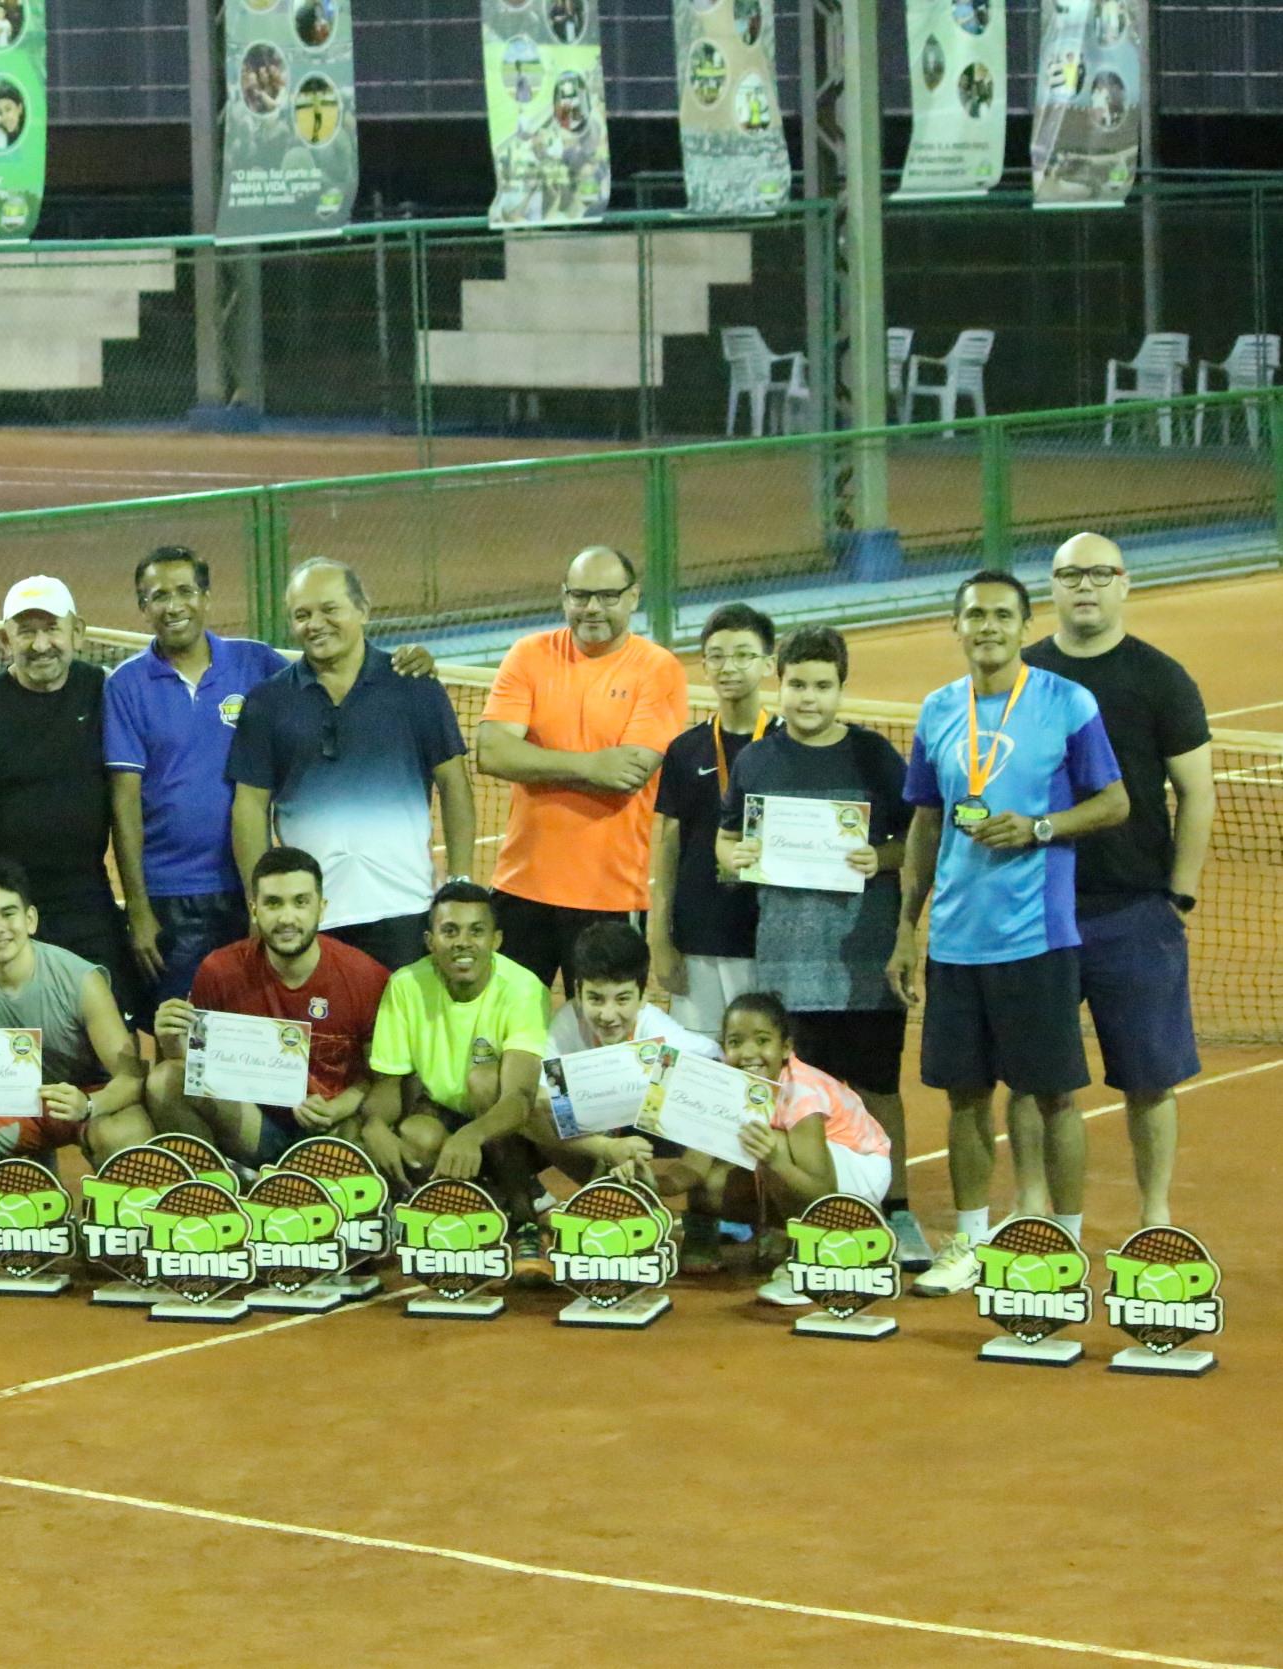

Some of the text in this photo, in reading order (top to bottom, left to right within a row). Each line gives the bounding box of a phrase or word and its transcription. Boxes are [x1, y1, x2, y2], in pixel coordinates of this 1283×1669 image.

[142, 1210, 247, 1251] TOP
[396, 1207, 504, 1250] TOP
[550, 1213, 658, 1256] TOP
[787, 1222, 891, 1267] TOP
[142, 1249, 250, 1280] TENNIS
[249, 1241, 339, 1270] ENNIS
[396, 1246, 505, 1278] TENNIS
[550, 1252, 660, 1284] TENNIS
[975, 1246, 1084, 1293] TOP
[787, 1262, 893, 1296] TENNIS
[1106, 1253, 1215, 1301] TOP
[974, 1286, 1086, 1322] TENNIS
[1104, 1296, 1216, 1332] TENNIS
